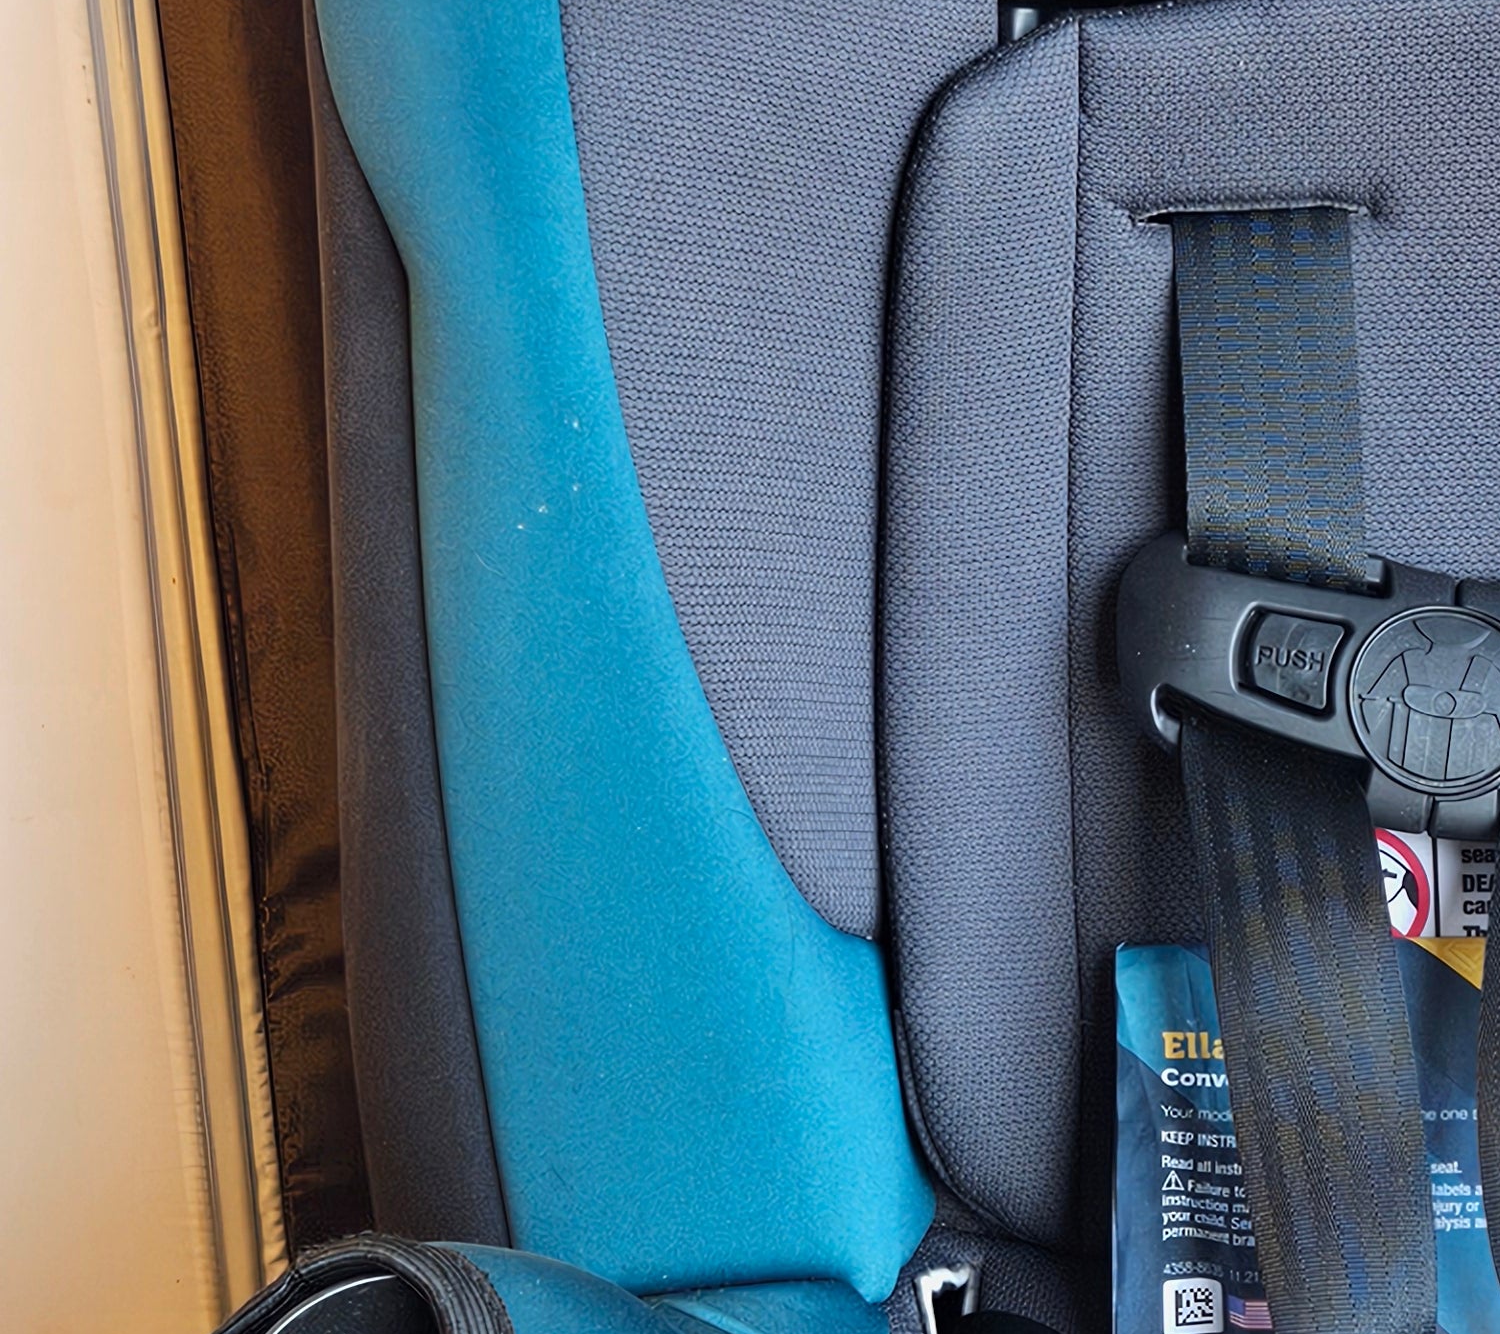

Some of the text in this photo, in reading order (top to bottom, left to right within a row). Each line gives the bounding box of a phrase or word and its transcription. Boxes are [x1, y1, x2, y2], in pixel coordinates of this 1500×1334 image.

[1255, 645, 1325, 672] PUSH
[1160, 1068, 1229, 1087] Conv
[1160, 1104, 1194, 1119] Your
[1440, 1109, 1468, 1121] one
[1161, 1130, 1194, 1145] KEEP
[1161, 1154, 1194, 1170] Read
[1197, 1160, 1212, 1173] all
[1187, 1179, 1230, 1198] Failure
[1431, 1183, 1471, 1196] labels
[1465, 1201, 1480, 1213] or
[1162, 1211, 1191, 1226] your
[1162, 1226, 1230, 1244] permanent
